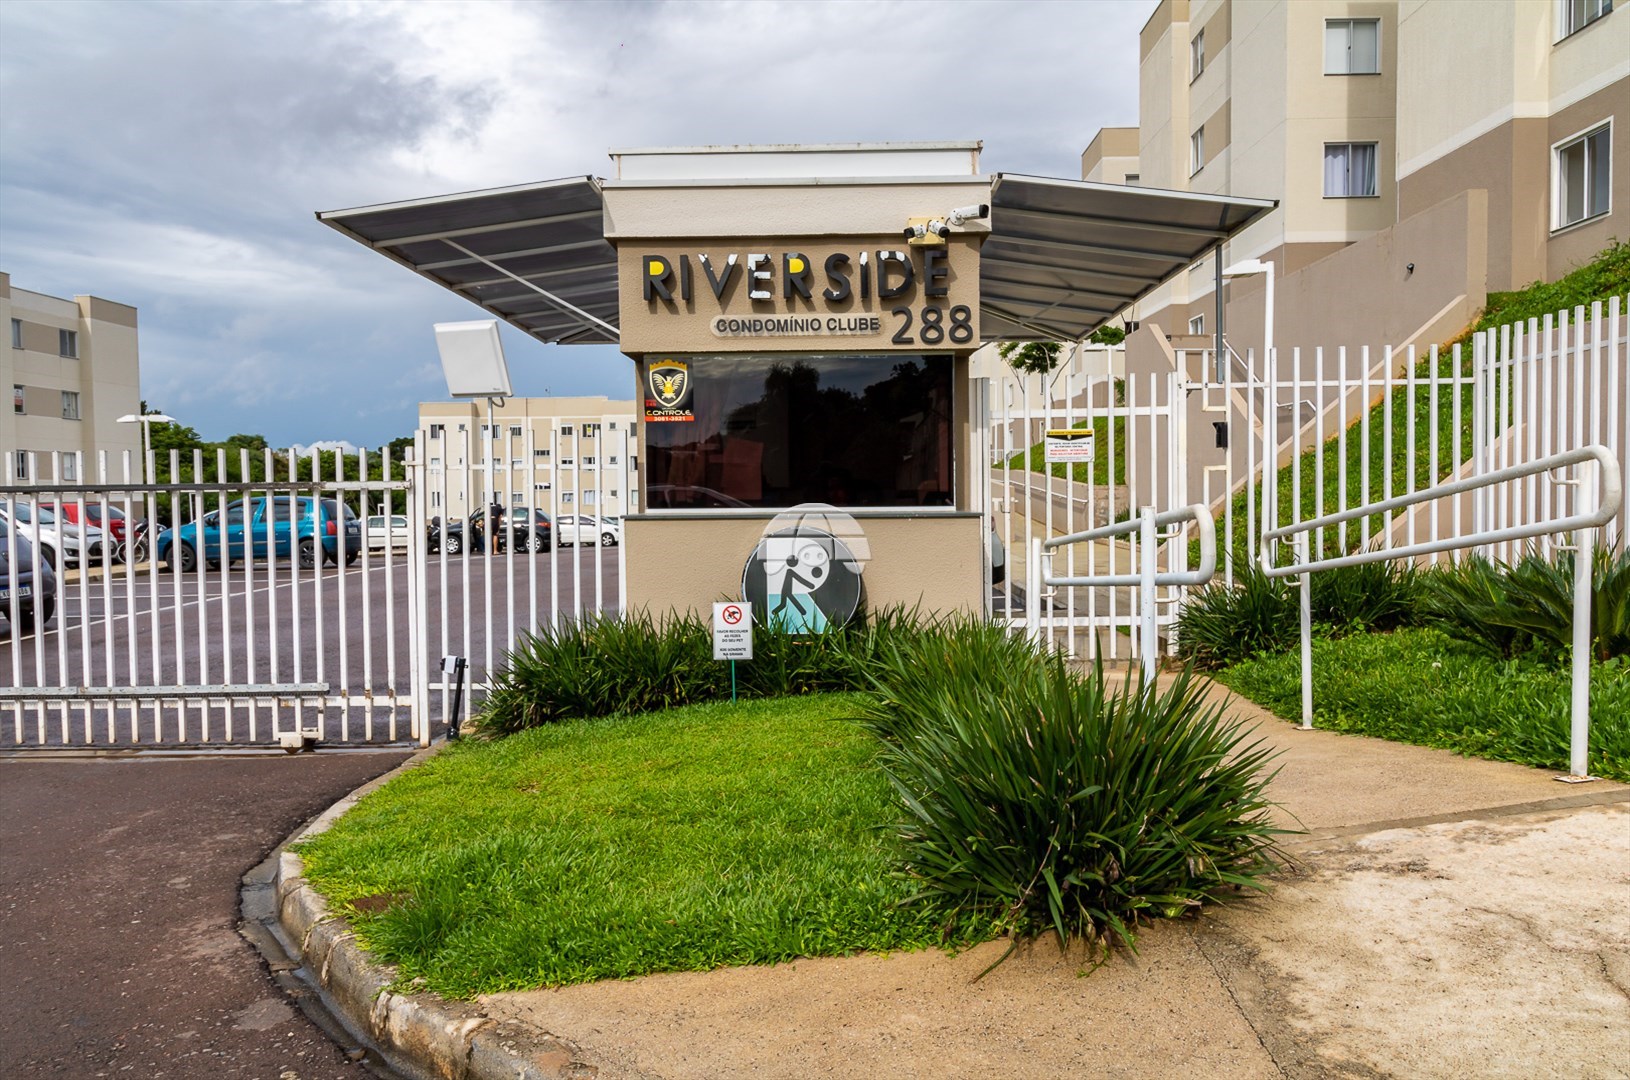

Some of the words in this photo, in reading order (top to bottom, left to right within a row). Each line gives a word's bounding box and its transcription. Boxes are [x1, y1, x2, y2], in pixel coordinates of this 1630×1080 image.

[643, 250, 948, 301] RIVERSIDE
[716, 316, 822, 333] CONDOMÍNIO
[826, 317, 880, 332] CLUBE
[891, 304, 974, 345] 288
